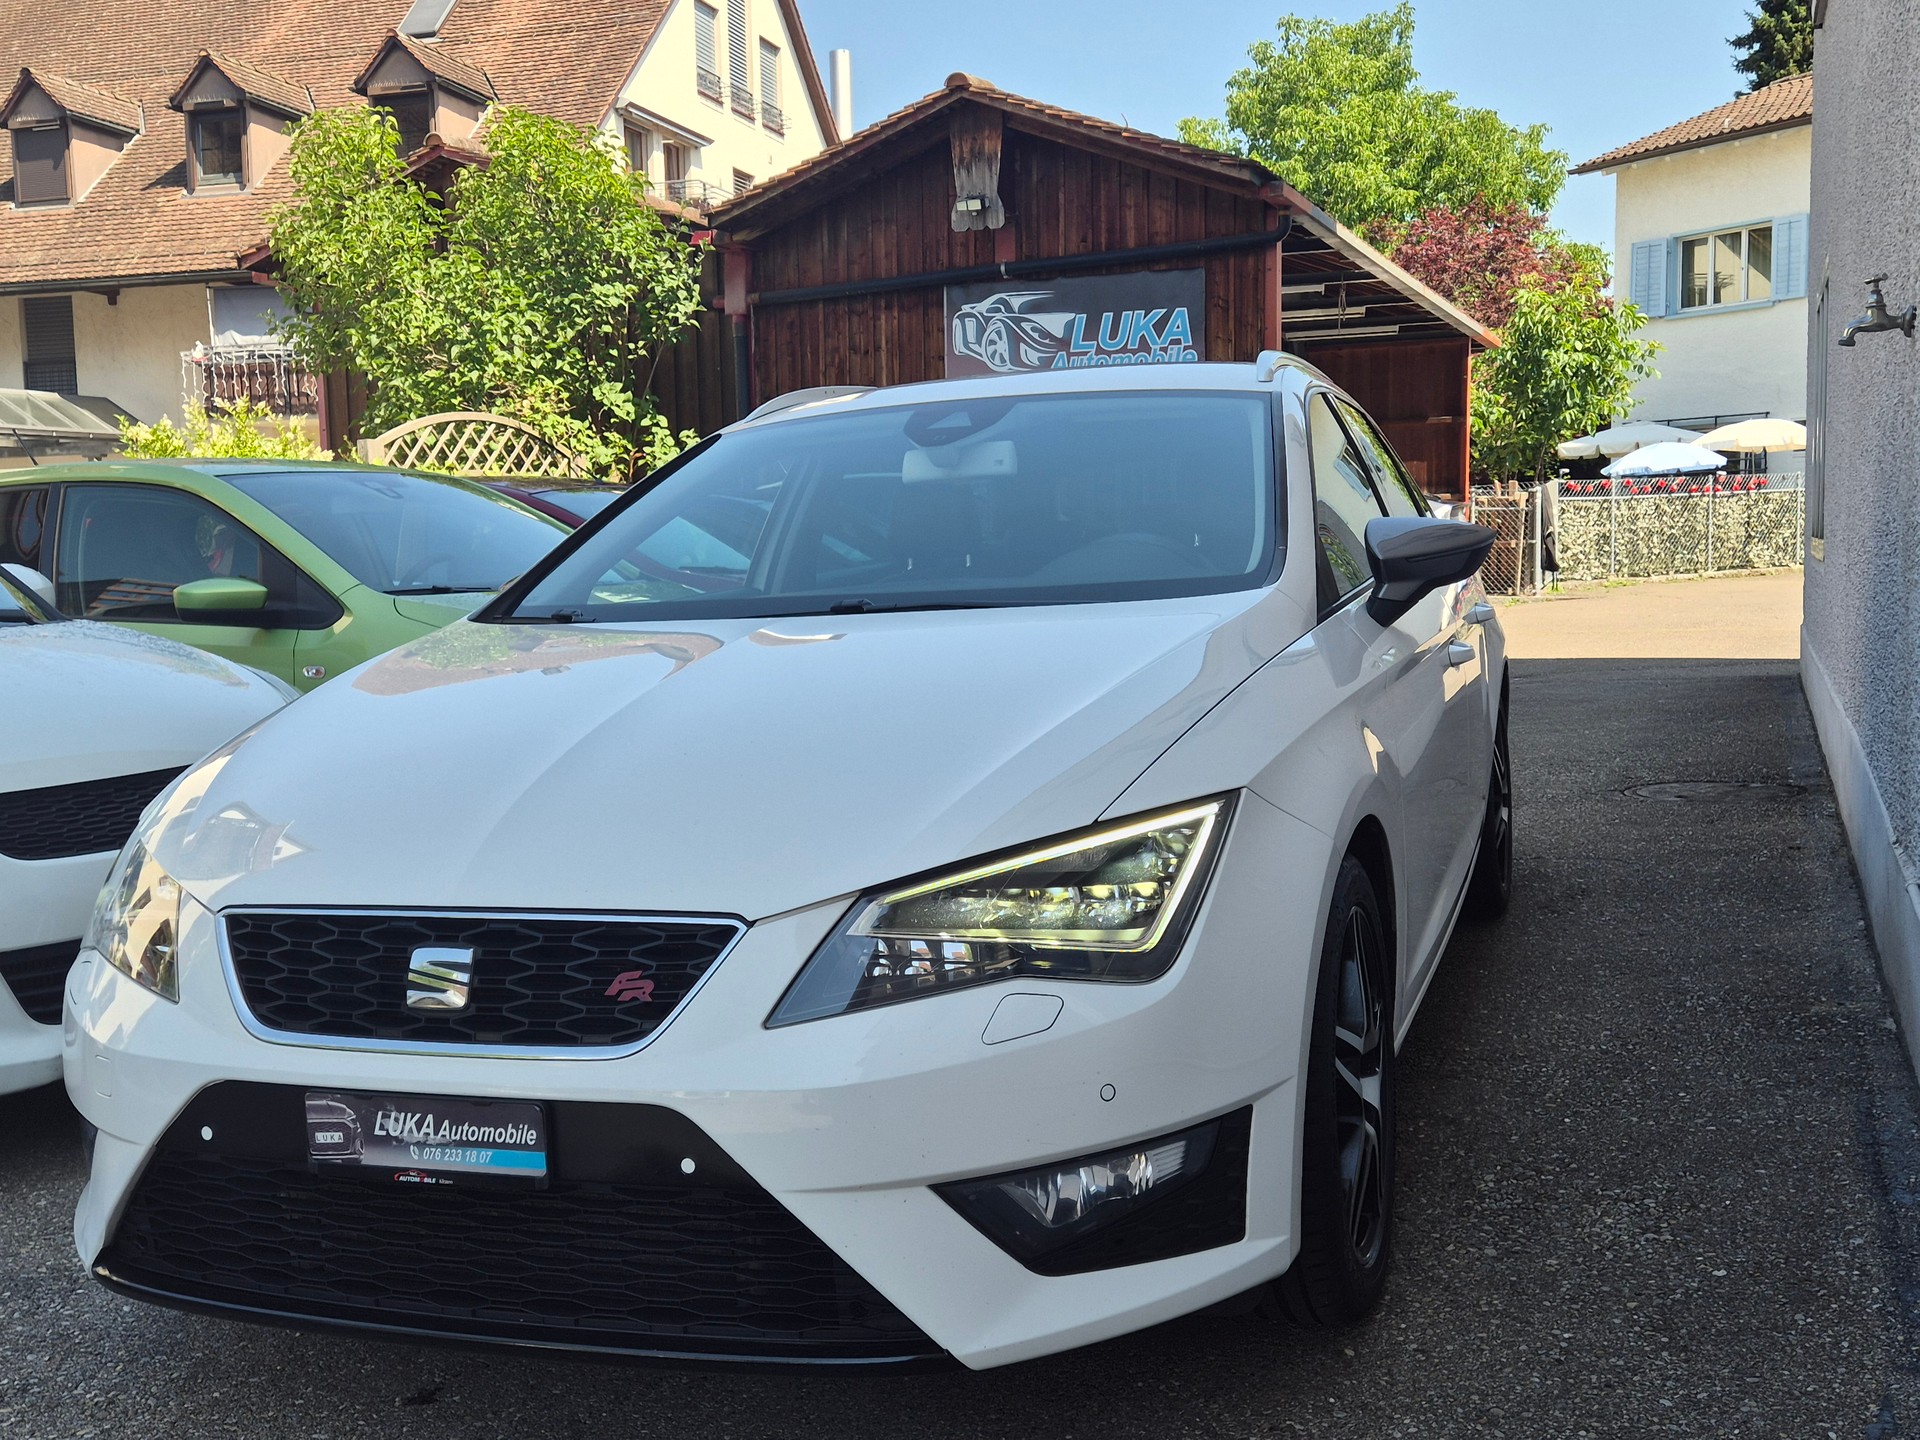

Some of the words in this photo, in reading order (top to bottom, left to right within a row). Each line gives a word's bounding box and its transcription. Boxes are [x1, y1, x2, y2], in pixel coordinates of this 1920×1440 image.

[1070, 307, 1193, 352] LUKA
[1051, 345, 1198, 369] Automobile
[604, 970, 655, 1002] FR
[316, 1133, 343, 1142] LUKA
[374, 1110, 437, 1138] LUKA
[438, 1119, 537, 1146] Automobile
[423, 1147, 441, 1160] 076
[444, 1148, 462, 1162] 233
[465, 1149, 477, 1163] 18
[479, 1151, 492, 1164] 07
